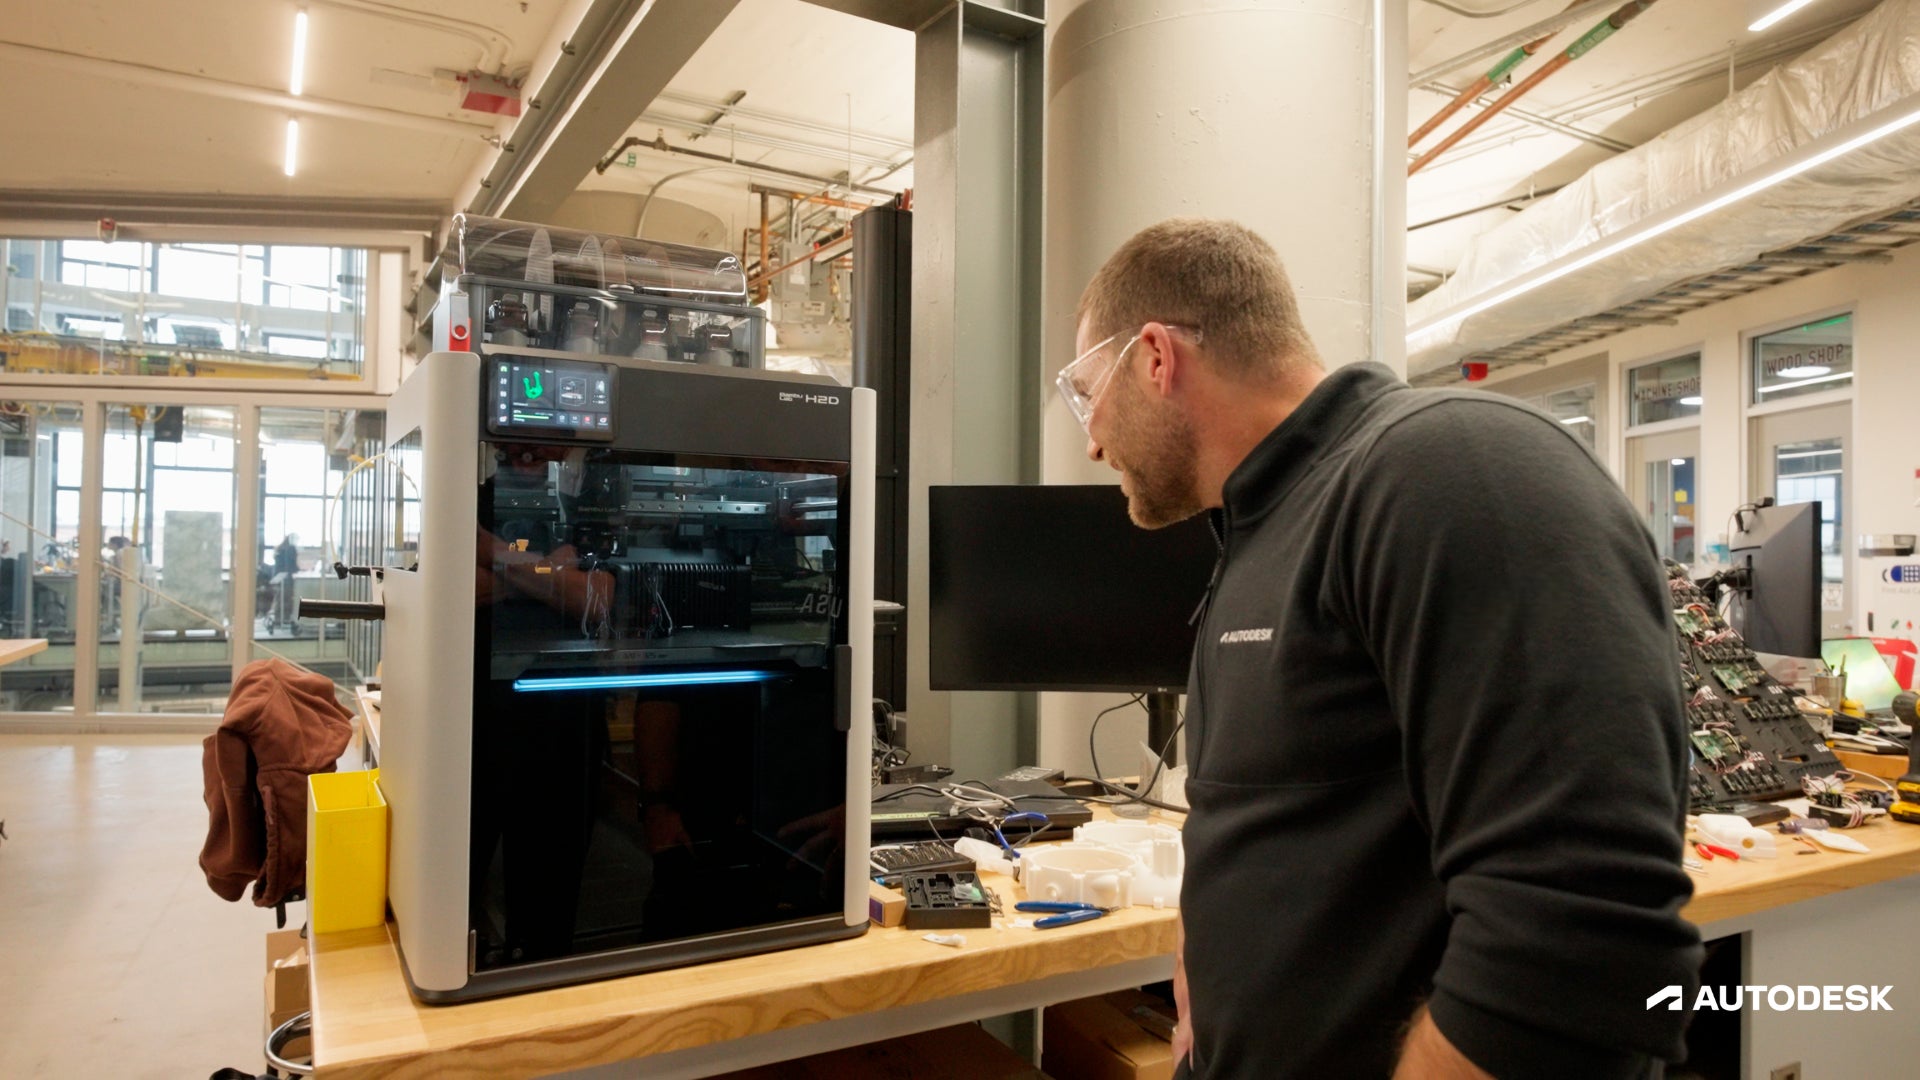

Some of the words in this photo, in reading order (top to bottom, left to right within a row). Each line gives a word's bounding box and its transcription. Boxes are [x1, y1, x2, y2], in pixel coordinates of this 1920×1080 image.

[1766, 352, 1802, 376] WOOD
[1808, 343, 1844, 366] SHOP
[805, 394, 840, 405] H2D
[1633, 382, 1673, 401] MACHINE
[1228, 628, 1273, 643] AUTODESK
